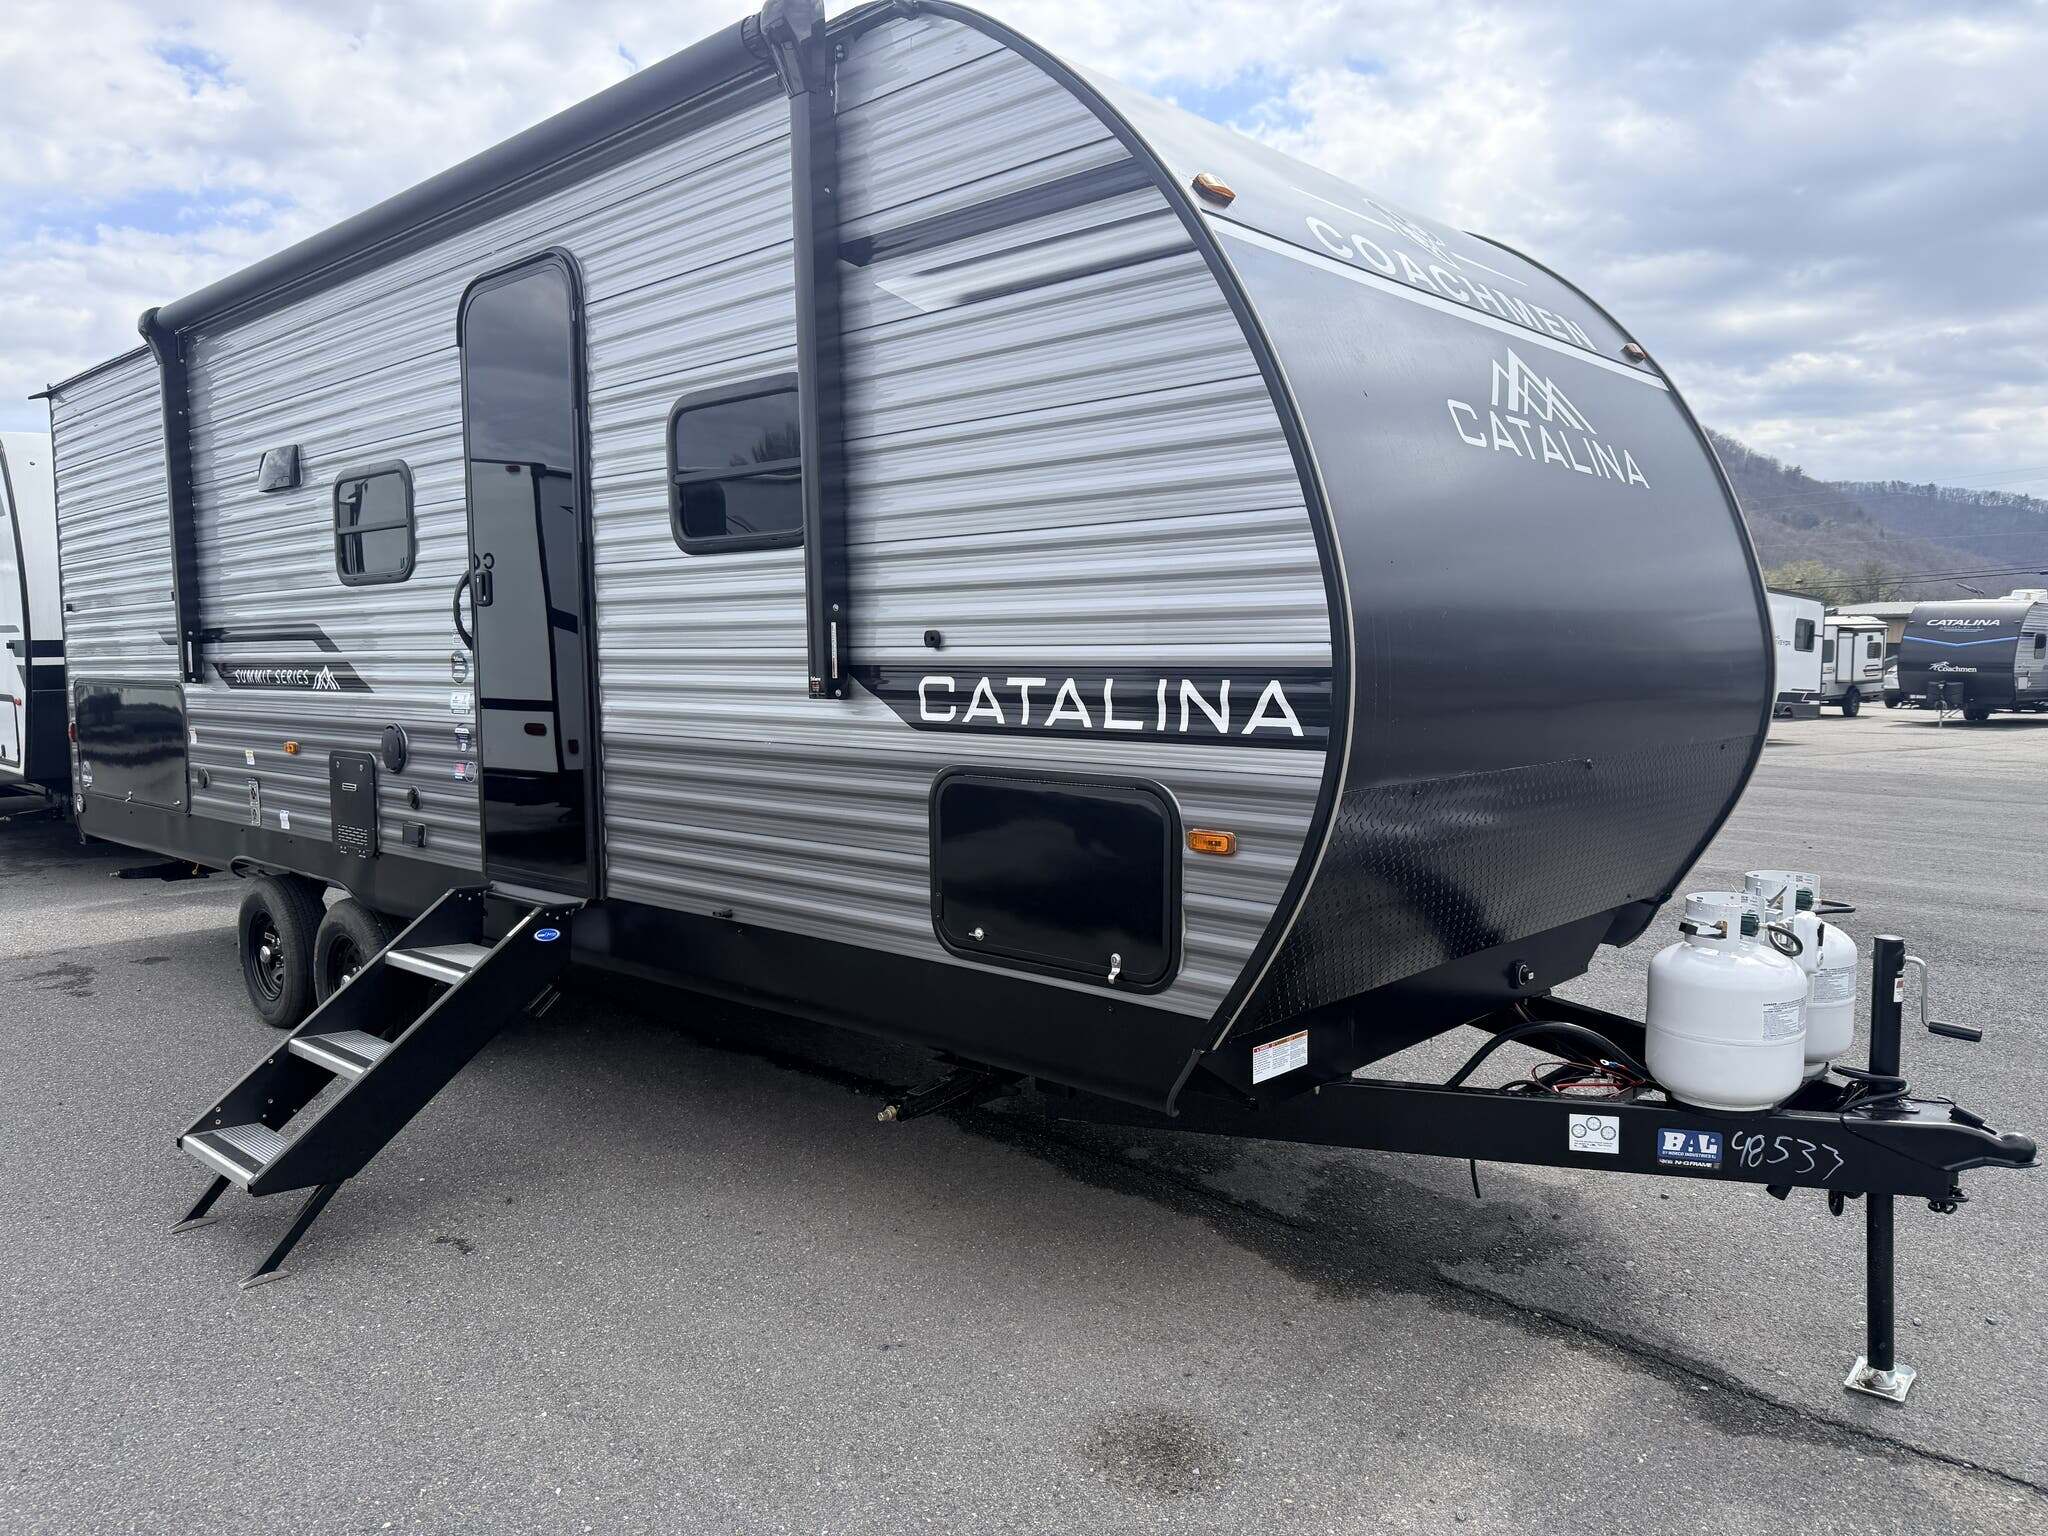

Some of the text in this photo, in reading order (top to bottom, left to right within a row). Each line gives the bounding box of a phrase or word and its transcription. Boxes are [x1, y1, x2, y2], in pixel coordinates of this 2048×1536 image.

[1305, 216, 1598, 352] COACHMEN
[1447, 398, 1651, 490] CATALINA
[234, 669, 310, 685] SUMMIT SERIES
[1937, 664, 1978, 673] Coachmen
[918, 675, 1304, 737] CATALINA
[1662, 1131, 1718, 1154] BAL
[1731, 1130, 1845, 1181] 48533
